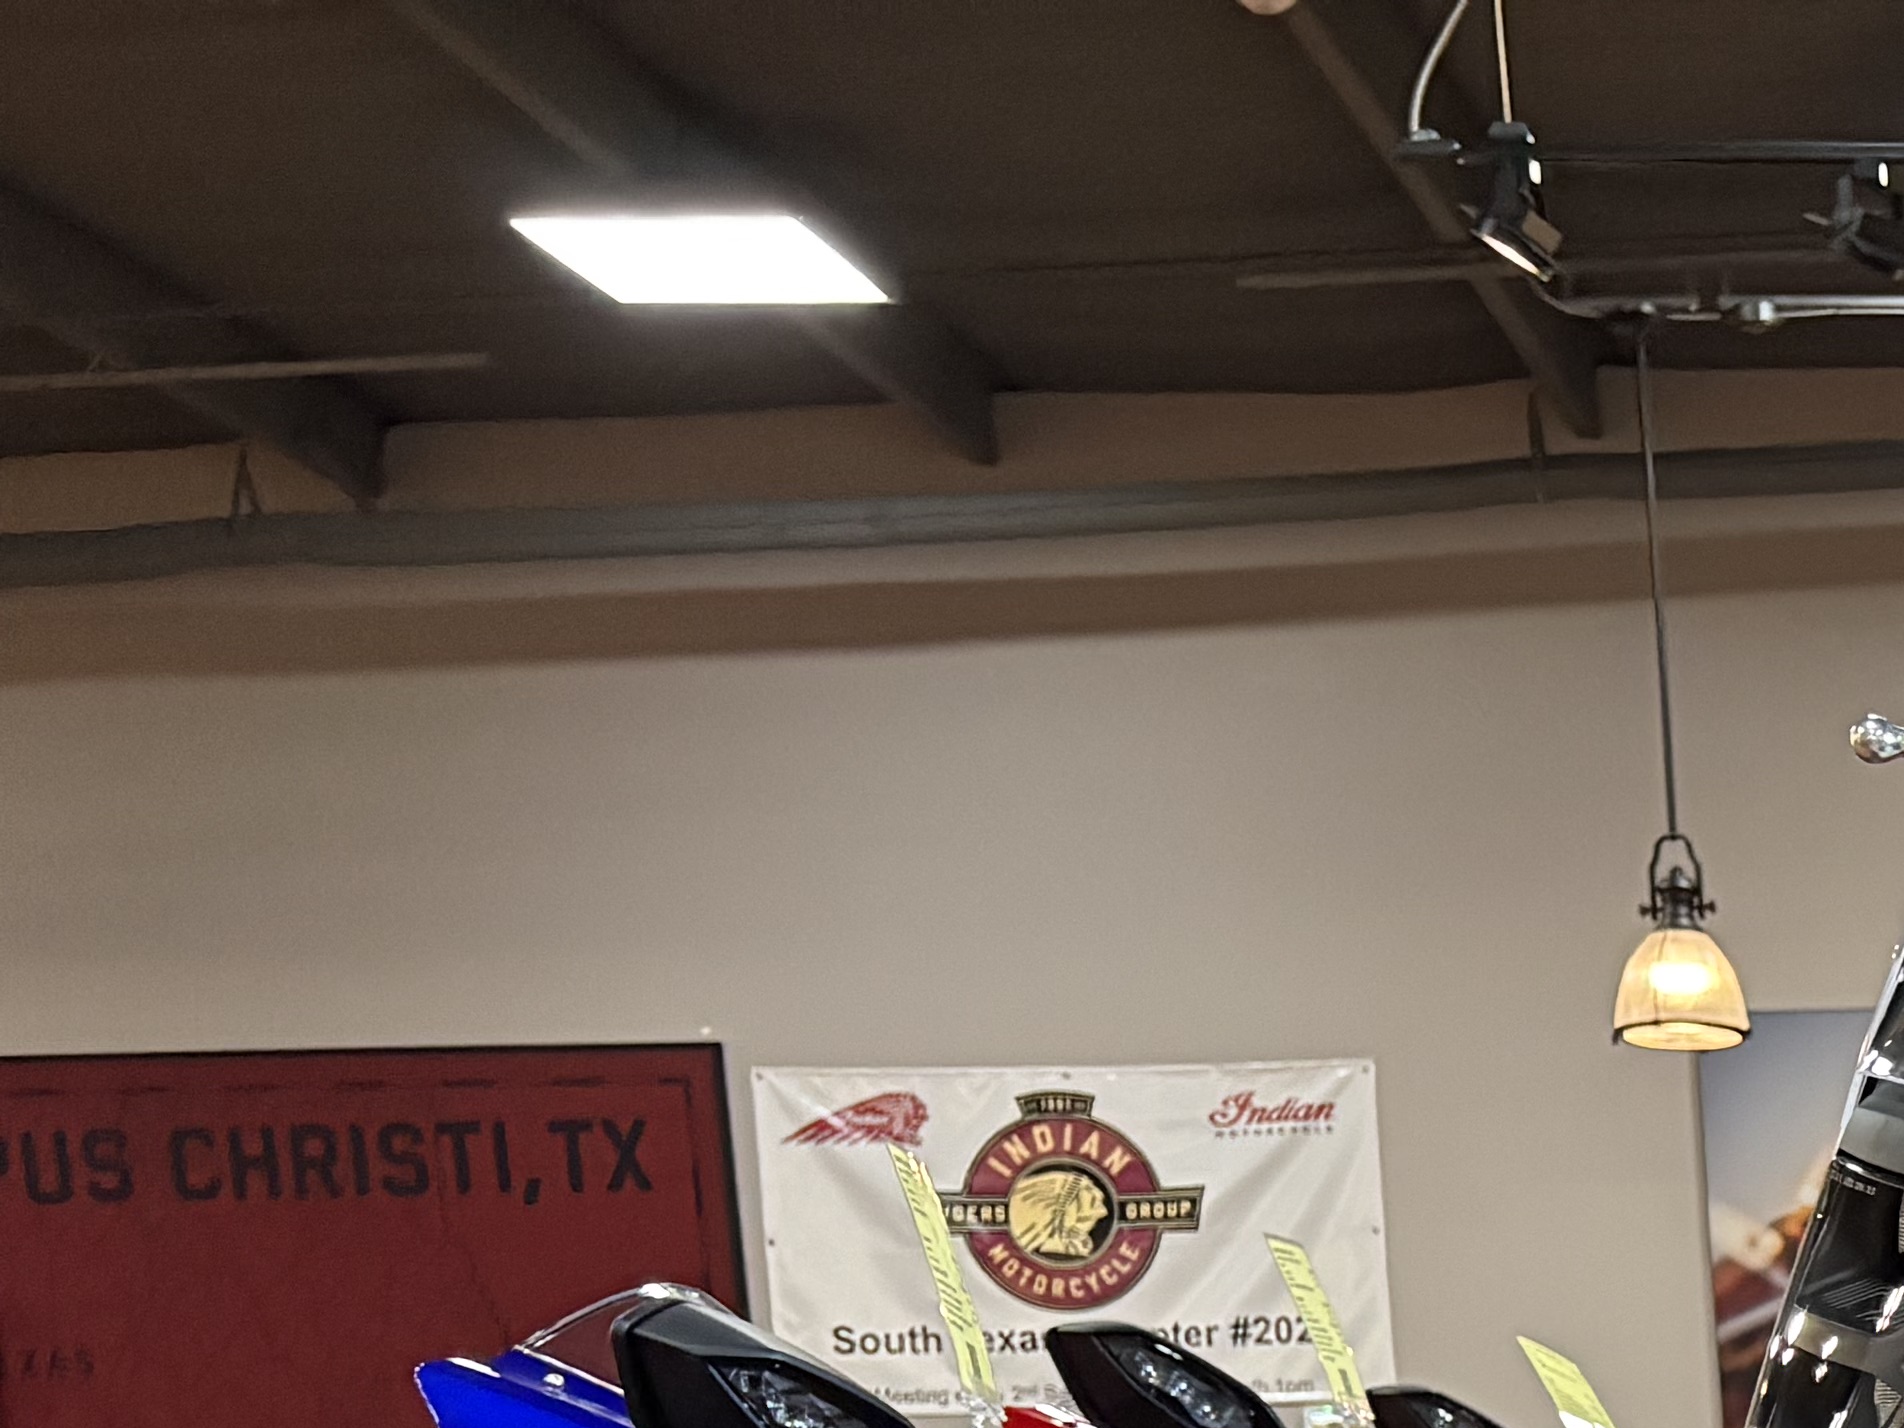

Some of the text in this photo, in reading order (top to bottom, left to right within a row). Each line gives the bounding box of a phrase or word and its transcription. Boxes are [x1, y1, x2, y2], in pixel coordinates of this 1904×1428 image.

[1208, 1090, 1336, 1128] Indian
[987, 1122, 1132, 1178] INDIAN
[943, 1200, 1192, 1224] DERS GROUP
[986, 1240, 1140, 1300] MOTORCYCLE
[832, 1325, 943, 1354] South
[981, 1329, 1049, 1354] exa
